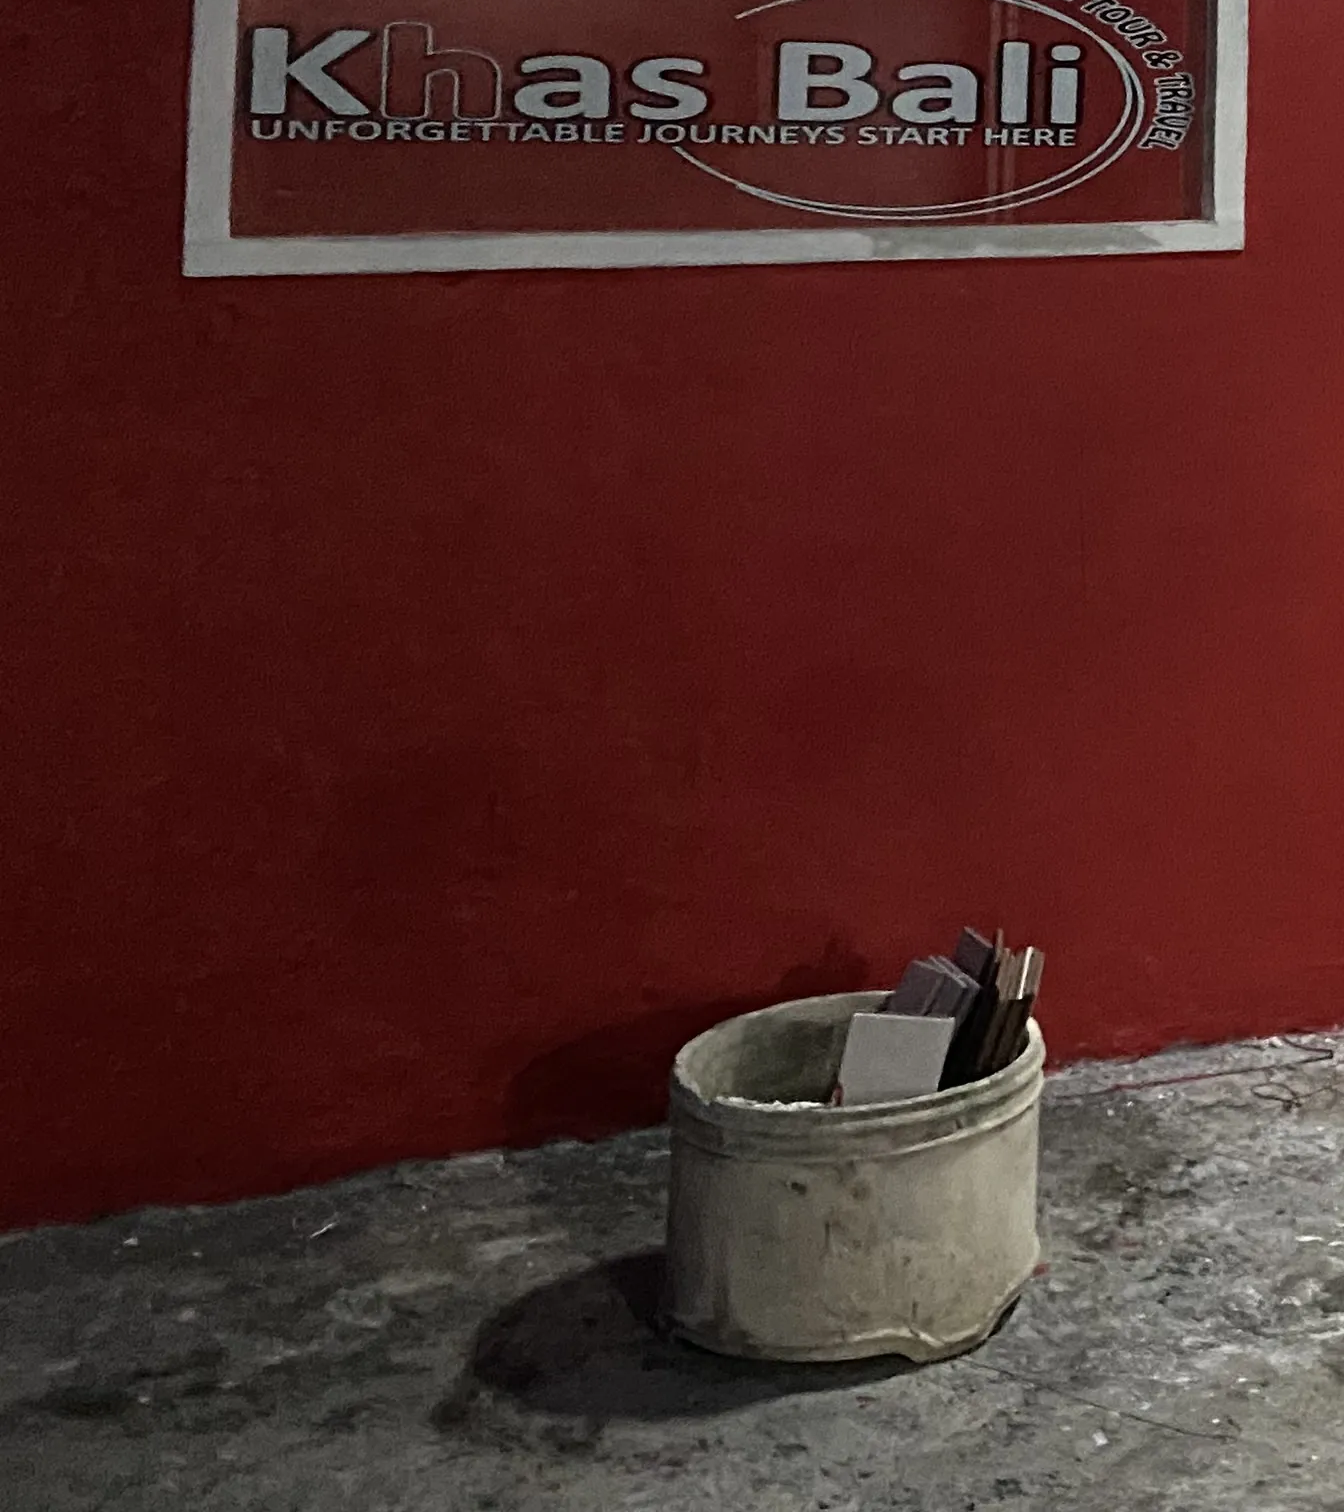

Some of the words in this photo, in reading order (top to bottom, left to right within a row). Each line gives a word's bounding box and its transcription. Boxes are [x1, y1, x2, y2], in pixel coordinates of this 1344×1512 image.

[248, 21, 711, 123] Khas
[777, 40, 1082, 125] Bali
[1142, 48, 1183, 72] &
[250, 118, 625, 144] UNFORGETTABLE
[635, 120, 846, 147] JOURNEYS
[857, 125, 972, 147] START
[984, 126, 1077, 147] HERE
[1138, 71, 1196, 151] TRAVEL
